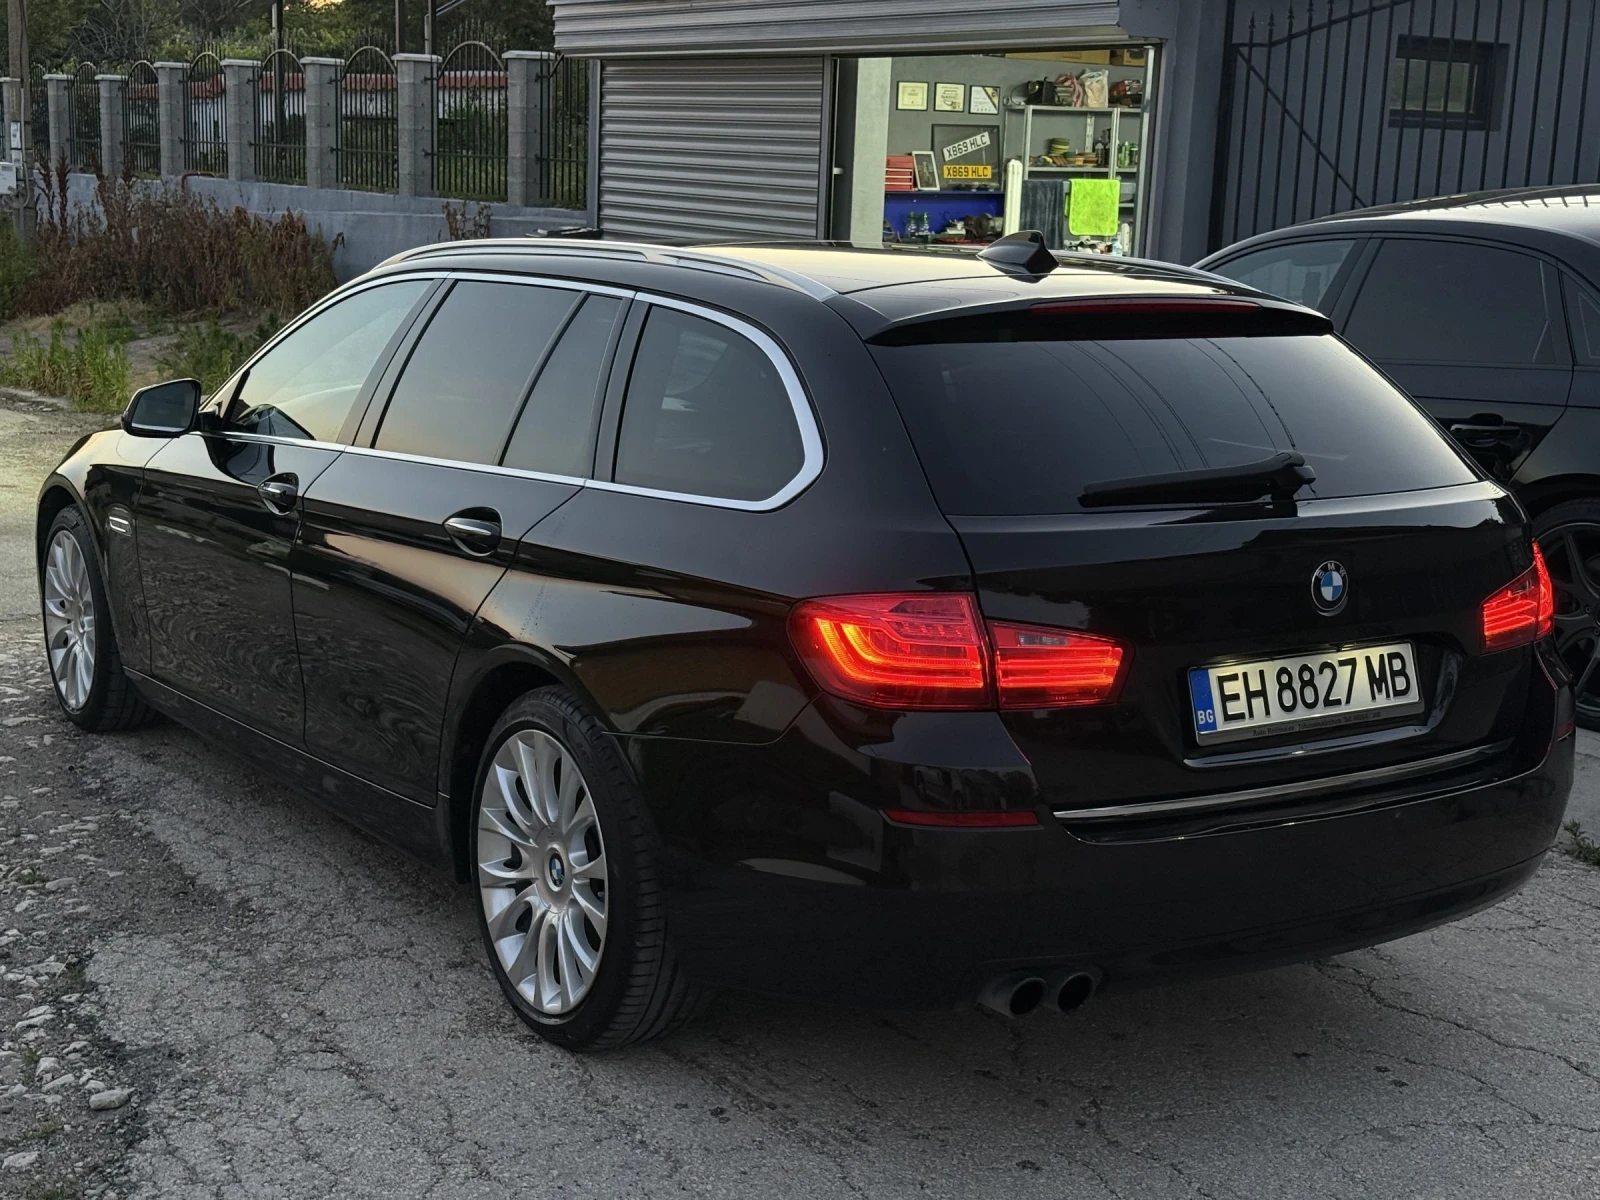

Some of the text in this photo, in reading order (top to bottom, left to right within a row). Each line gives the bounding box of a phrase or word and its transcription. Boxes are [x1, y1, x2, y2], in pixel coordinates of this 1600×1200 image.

[946, 134, 987, 159] X869 HLC
[946, 166, 989, 178] X869 HLC
[1316, 562, 1347, 579] BMW
[1216, 651, 1411, 722] EH 8827 MB
[1197, 709, 1214, 724] BG
